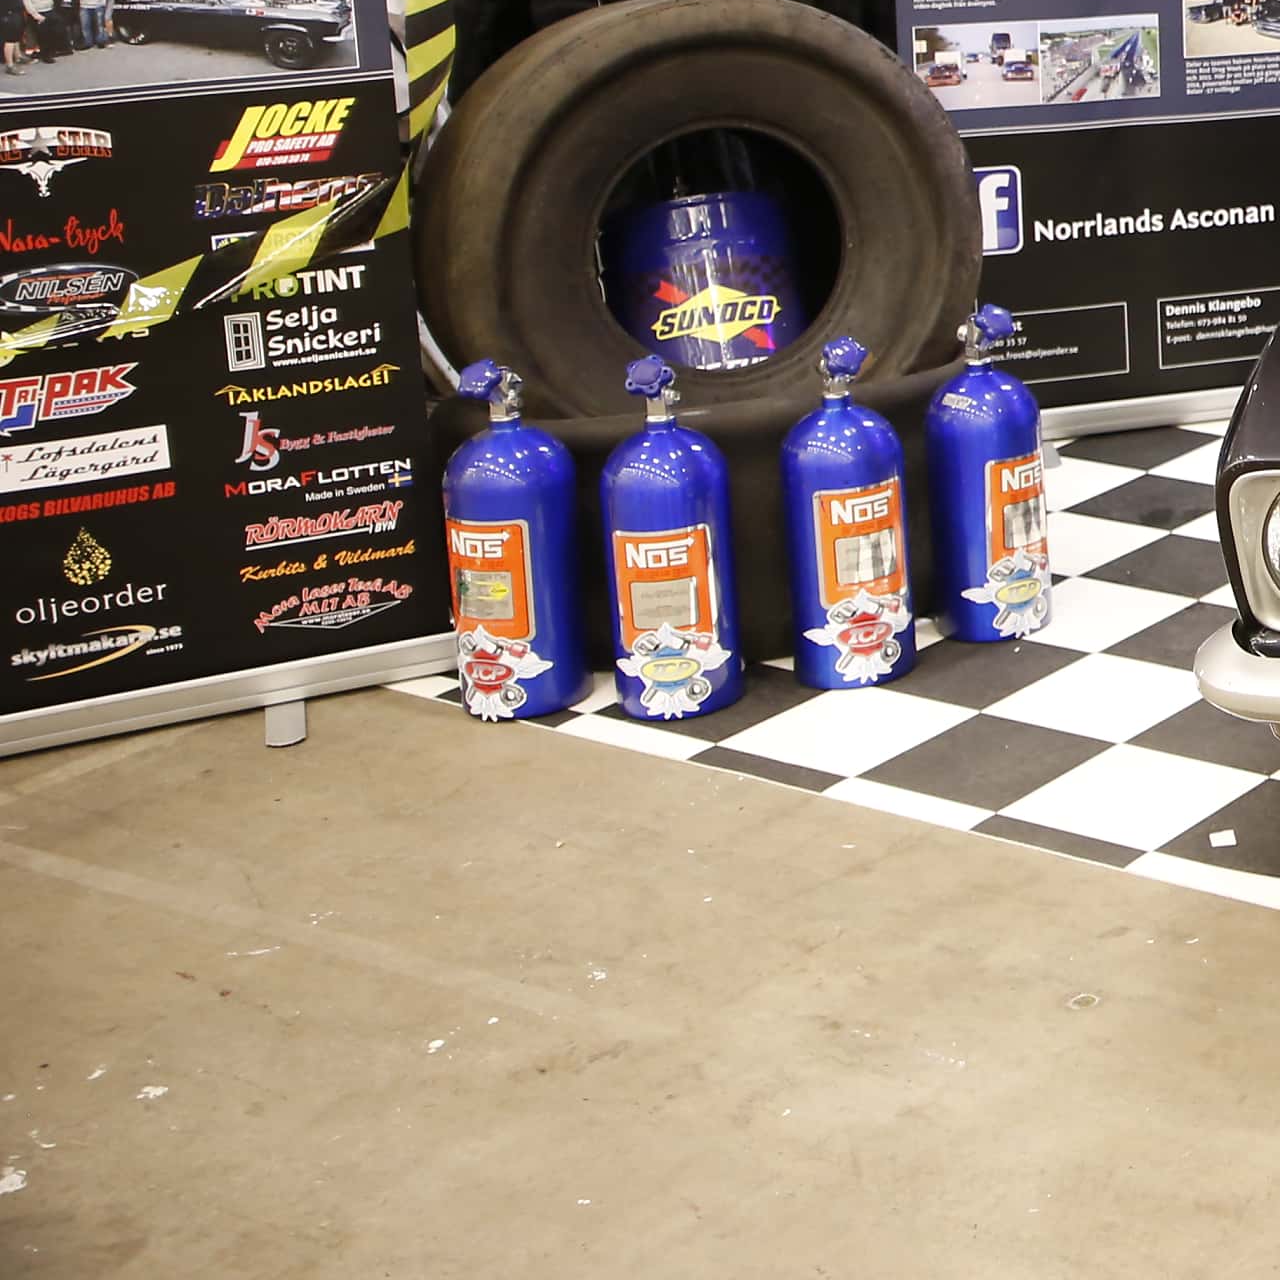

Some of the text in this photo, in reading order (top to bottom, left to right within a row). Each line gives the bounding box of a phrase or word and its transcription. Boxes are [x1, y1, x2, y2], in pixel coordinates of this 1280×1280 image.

[209, 97, 355, 172] JOCKE
[247, 138, 275, 154] PRO
[273, 134, 318, 152] SAFETY
[1034, 204, 1275, 242] Norrlands Asconan
[15, 272, 124, 301] NILSEN
[266, 306, 337, 331] Selja
[659, 299, 774, 337] SUNOCO
[1165, 296, 1261, 316] Dennis Klangebo
[267, 323, 381, 357] Snickeri
[16, 434, 159, 463] Lofsdalens
[20, 450, 159, 482] Lägergård
[1001, 460, 1041, 493] NOS
[43, 485, 150, 517] BILVARUHUS
[152, 481, 177, 499] AB
[305, 481, 385, 503] Made in Sweden
[830, 487, 891, 525] NOS
[451, 529, 507, 559] NOS
[625, 537, 693, 569] NOS
[240, 539, 416, 583] Kurbits & Vildmark
[16, 583, 167, 624] oljeorder
[342, 592, 370, 608] AB
